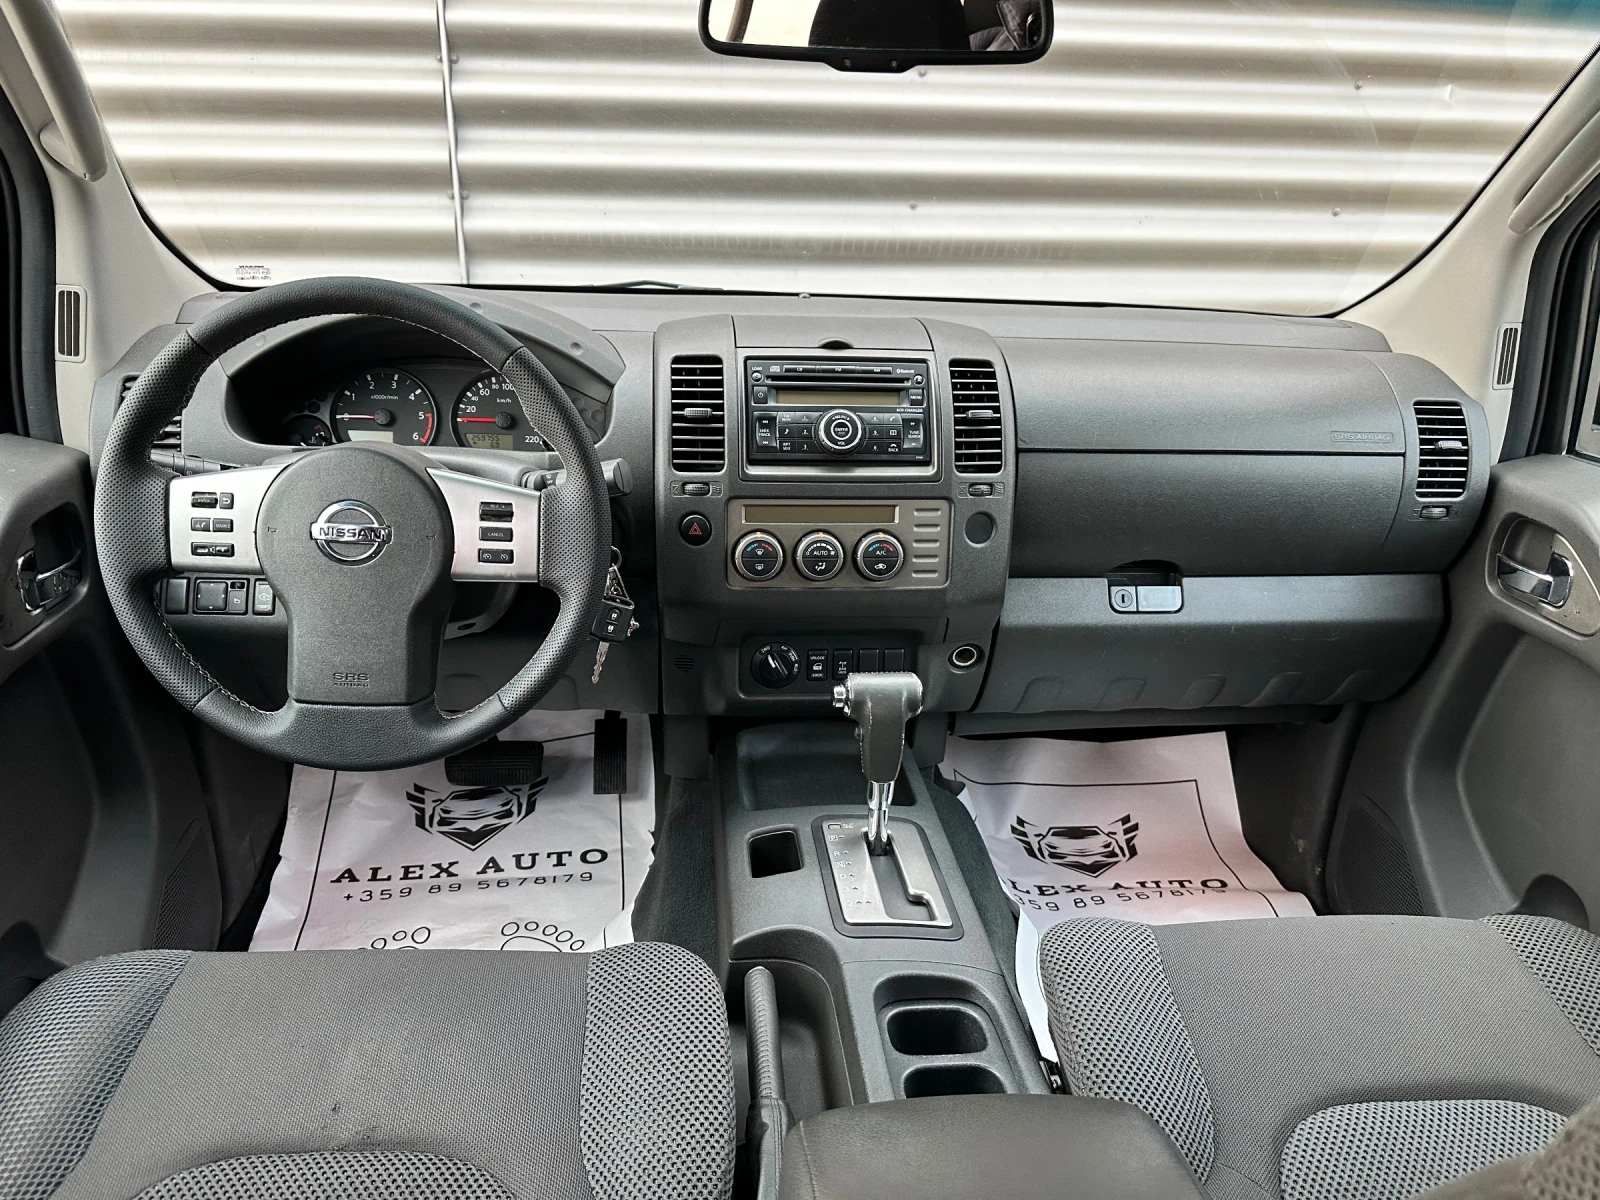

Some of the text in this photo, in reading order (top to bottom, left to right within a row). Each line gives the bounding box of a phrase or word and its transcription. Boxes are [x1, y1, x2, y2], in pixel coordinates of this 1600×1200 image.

[369, 381, 375, 390] 2
[391, 380, 397, 389] 3
[501, 383, 514, 391] 100
[408, 392, 415, 401] 4
[479, 388, 490, 396] 60
[351, 393, 356, 401] 1
[466, 405, 477, 413] 20
[418, 412, 425, 420] 5
[412, 432, 419, 440] 6
[524, 435, 540, 443] 220
[319, 526, 386, 541] NISSAN
[332, 672, 369, 681] SRS
[330, 848, 609, 883] ALEX AUTO
[343, 871, 593, 902] +359 89 5678179
[1001, 877, 1228, 896] LEX AUTO
[1073, 895, 1105, 909] 89
